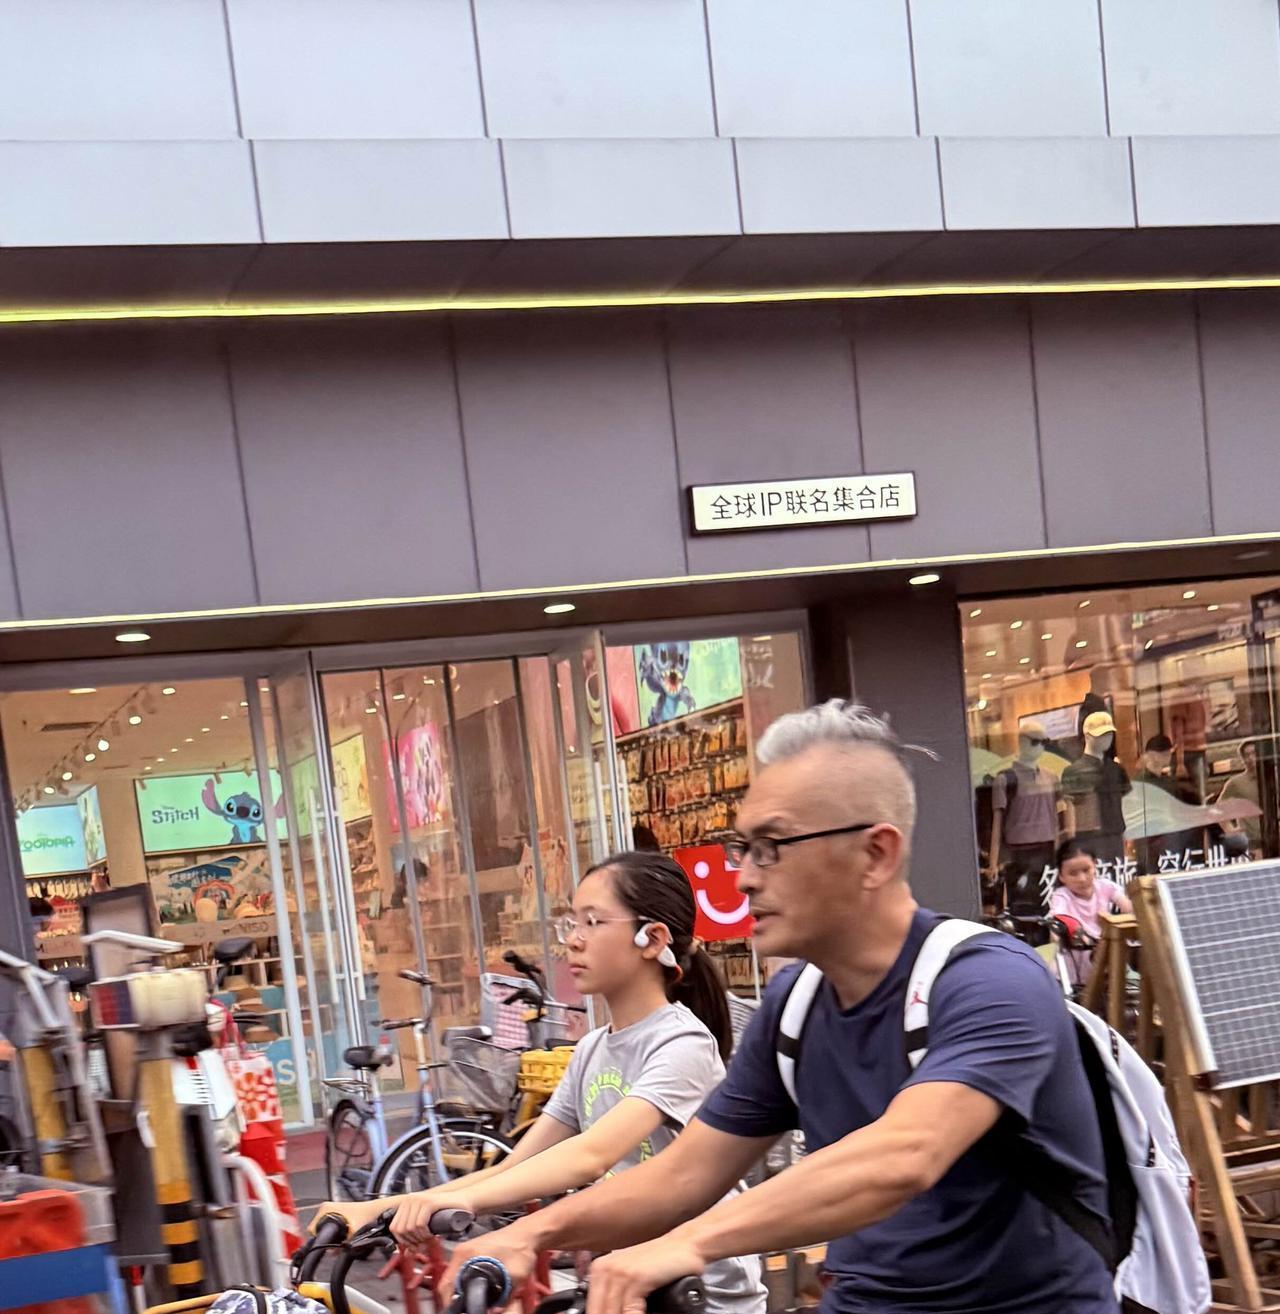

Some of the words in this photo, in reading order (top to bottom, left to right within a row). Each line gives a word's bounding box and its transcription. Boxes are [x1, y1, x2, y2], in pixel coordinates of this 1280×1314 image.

[710, 484, 900, 520] 全球IP联名集合店
